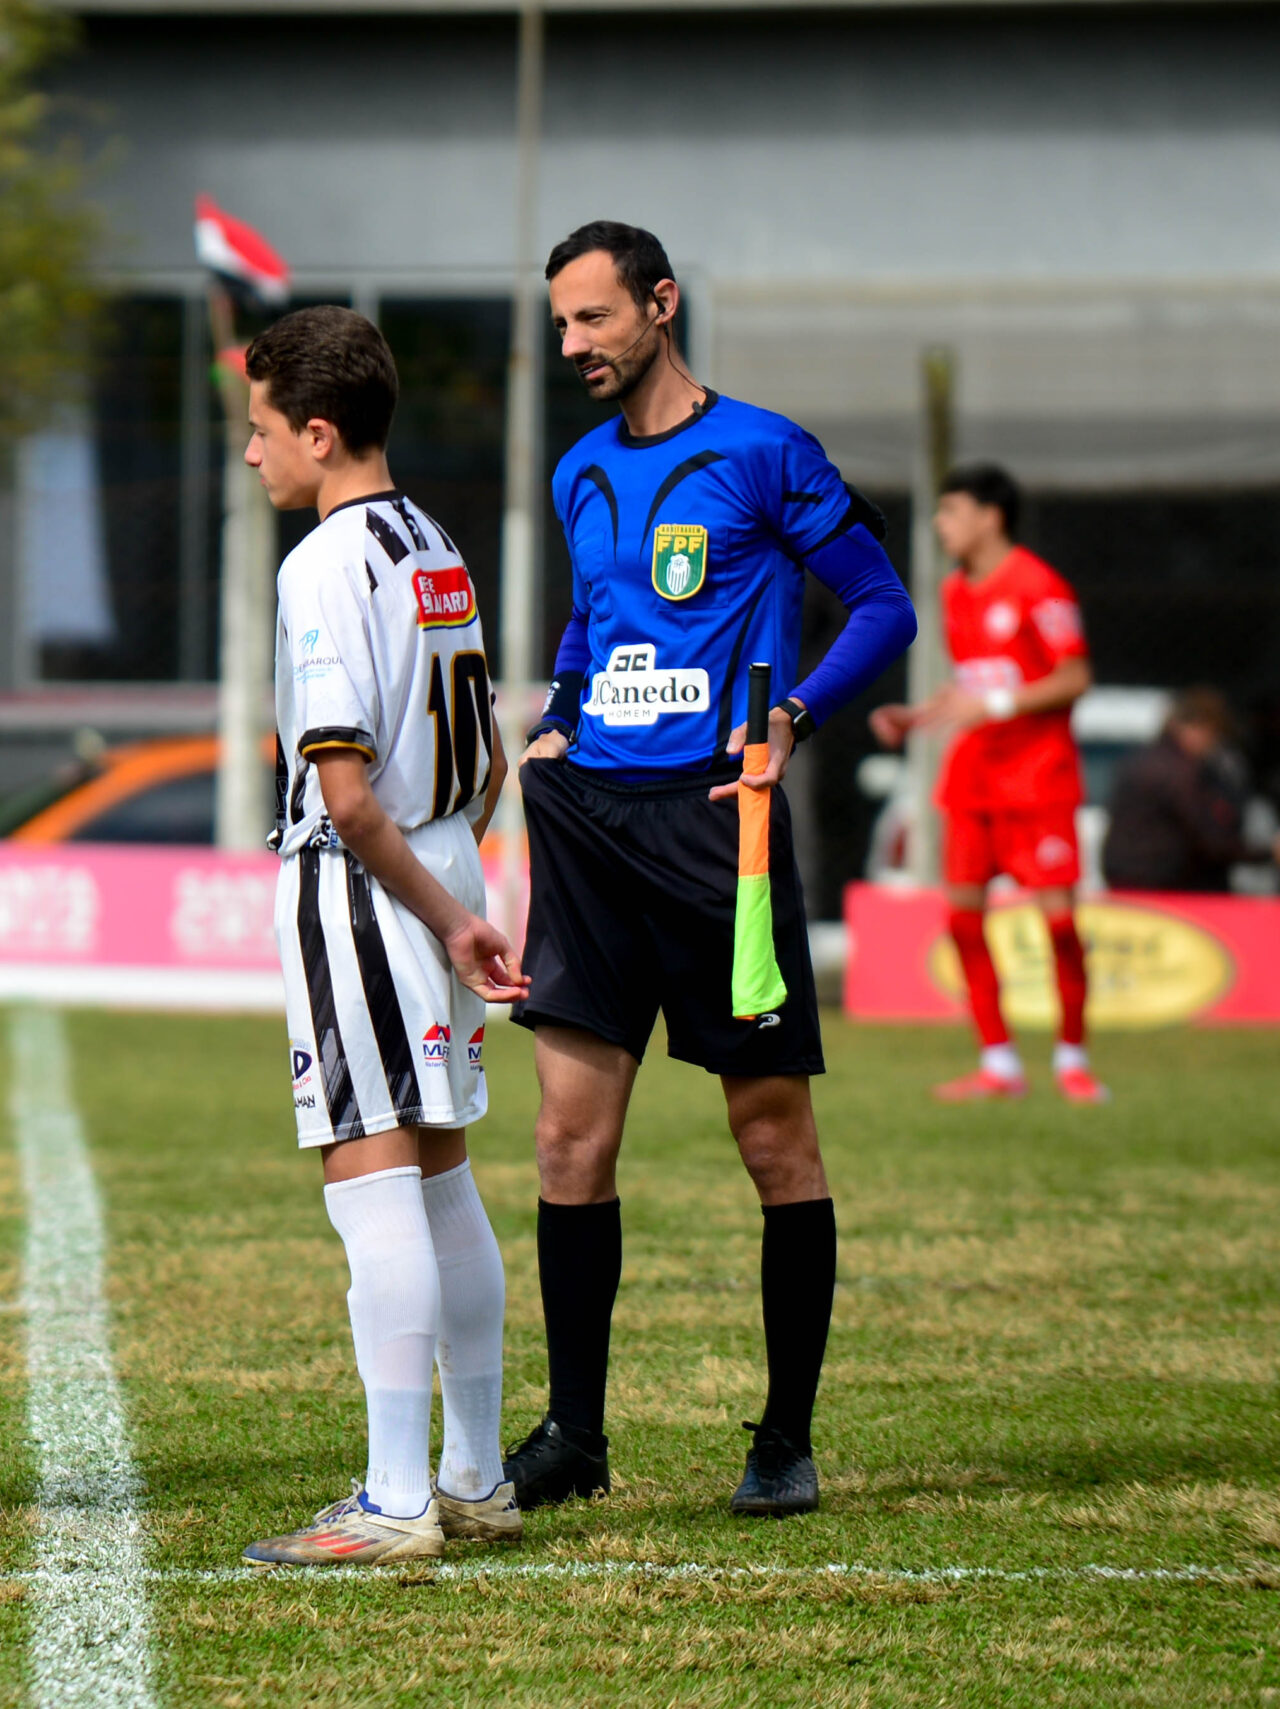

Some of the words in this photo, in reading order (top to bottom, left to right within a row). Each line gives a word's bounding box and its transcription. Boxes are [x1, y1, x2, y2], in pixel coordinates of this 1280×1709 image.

[657, 535, 703, 553] FPF
[593, 676, 700, 706] JCanedo
[609, 709, 650, 718] HOMEM
[427, 649, 493, 822] 10
